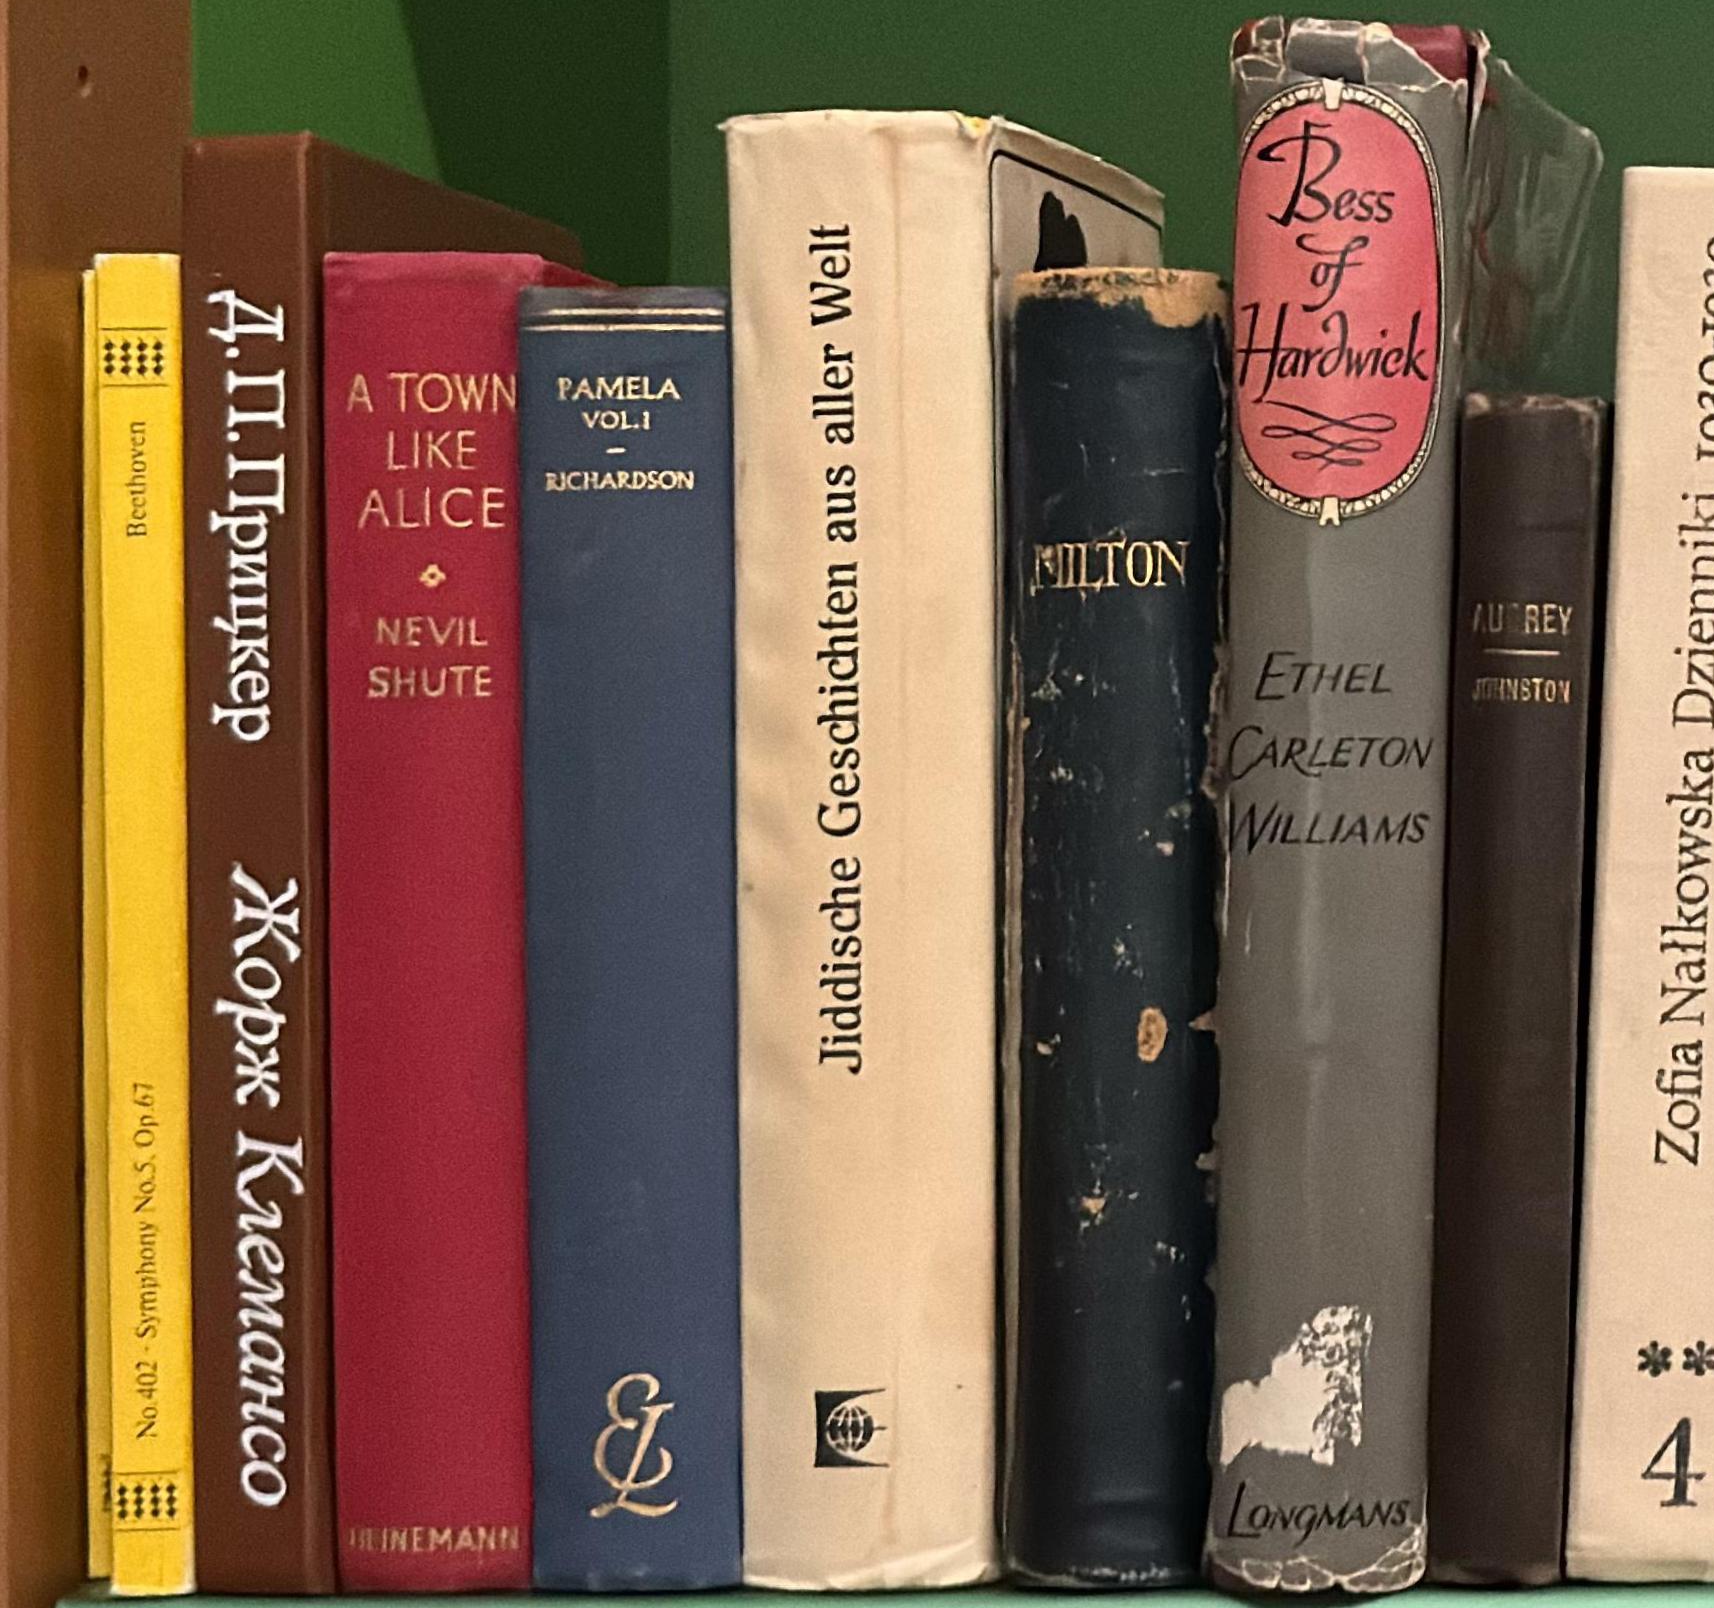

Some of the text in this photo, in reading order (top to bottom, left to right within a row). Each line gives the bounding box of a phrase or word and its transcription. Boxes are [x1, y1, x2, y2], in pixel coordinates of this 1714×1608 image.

[1257, 120, 1395, 226] Bess
[1296, 233, 1370, 312] of
[1237, 302, 1428, 403] Hardwick
[347, 371, 517, 414] A TOWN
[557, 375, 682, 401] PAMELA
[386, 430, 477, 471] LIKE
[125, 421, 147, 537] Beethoven
[545, 470, 696, 491] RICHARDSON
[358, 486, 505, 529] ALICE
[1032, 539, 1191, 592] MILTON
[376, 616, 488, 647] NEVIL
[1473, 602, 1573, 636] AUREY
[808, 224, 863, 1075] Jiddische Geschichten aus aller Welt
[1255, 651, 1392, 700] ETHEL
[368, 664, 492, 699] SHUTE
[1228, 724, 1433, 781] CARLETON
[1229, 799, 1430, 855] WILLIAMS
[1660, 747, 1714, 1026] Nałkowska
[1654, 1040, 1703, 1166] Zofia
[215, 861, 305, 1507] Жорж Клемансо
[135, 1221, 159, 1339] Symphony
[1641, 1416, 1707, 1507] 4
